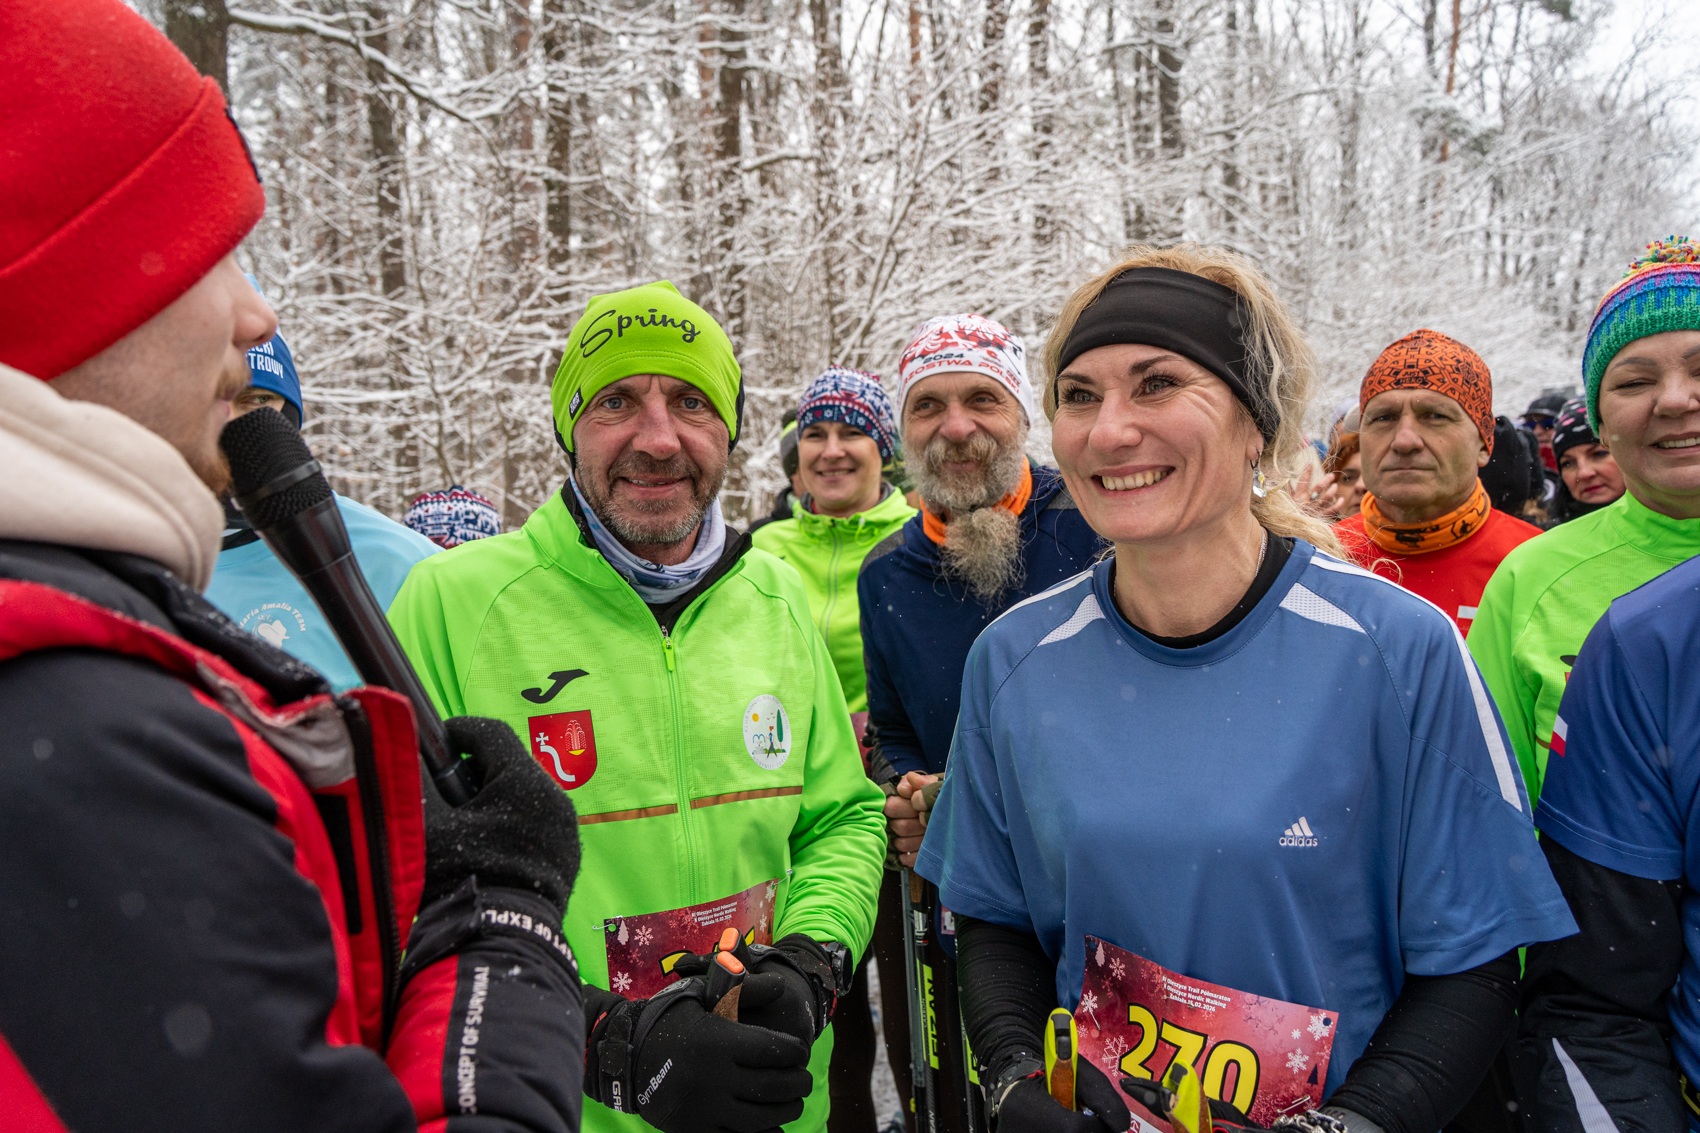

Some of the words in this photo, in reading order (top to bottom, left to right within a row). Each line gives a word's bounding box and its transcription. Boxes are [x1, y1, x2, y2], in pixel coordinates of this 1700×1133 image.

[580, 308, 701, 358] Spring
[245, 352, 284, 379] TROWY
[923, 353, 964, 364] 2024
[979, 361, 1020, 394] POLSKI
[261, 602, 292, 612] Amalia
[292, 608, 306, 632] TEAM
[1279, 835, 1318, 847] adidas
[481, 910, 532, 931] EXPL
[534, 923, 552, 942] OF
[465, 965, 490, 1026] SURVIVAL
[1167, 978, 1187, 990] Oleszyce
[1187, 986, 1200, 994] Trail
[1200, 989, 1231, 1002] Półmaraton
[1167, 985, 1187, 997] Oleszyce
[1187, 993, 1205, 1002] Nordic
[1205, 997, 1227, 1009] Walking
[461, 1026, 479, 1046] OF
[1118, 1003, 1260, 1115] 270
[637, 1058, 674, 1105] GymBeam
